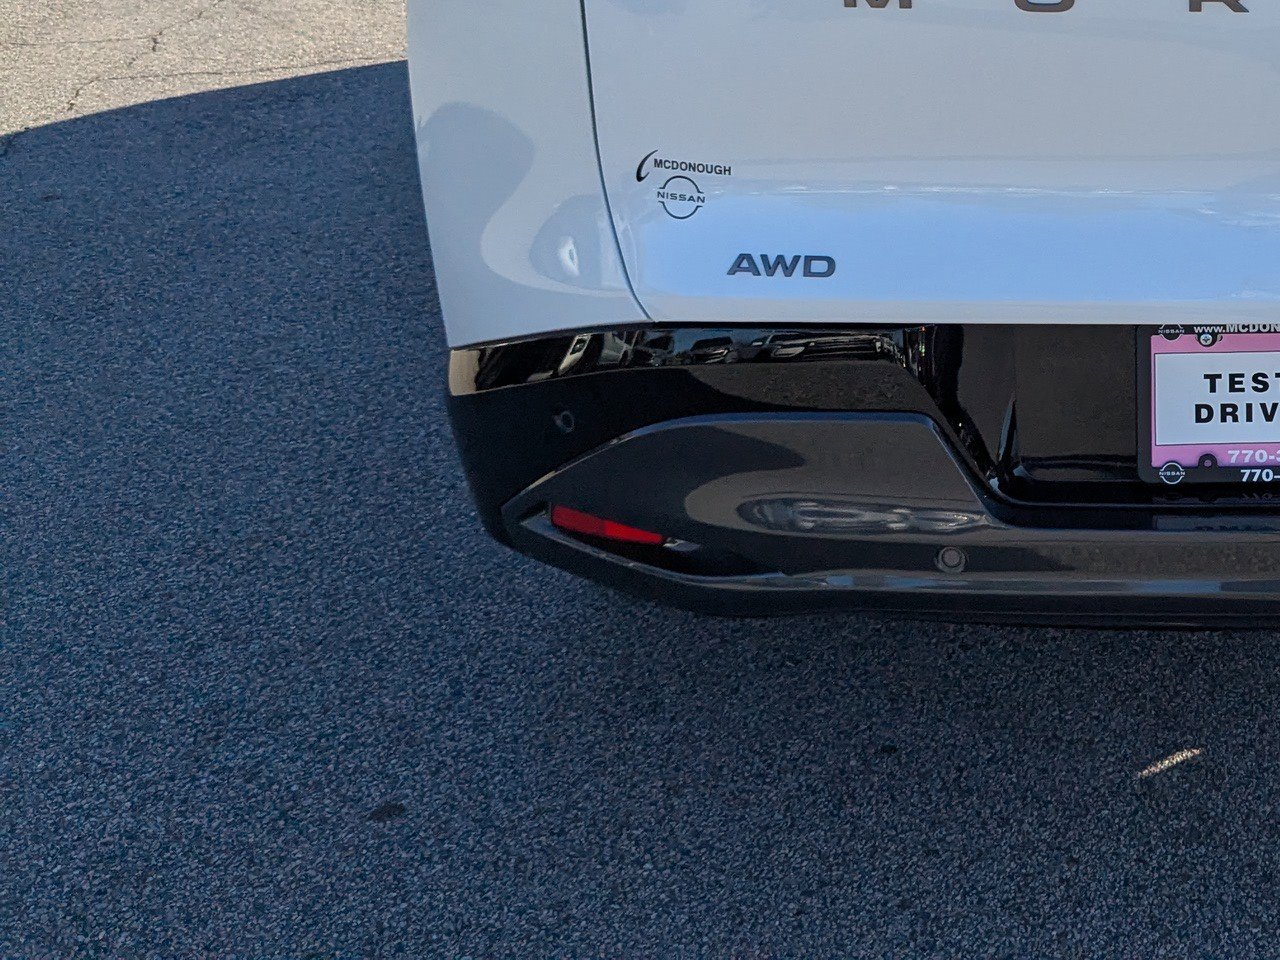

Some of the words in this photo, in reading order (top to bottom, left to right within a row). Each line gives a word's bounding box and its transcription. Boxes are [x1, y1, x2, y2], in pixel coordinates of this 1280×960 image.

[653, 158, 732, 176] MCDONOUGH
[656, 191, 706, 204] NISSAN
[726, 253, 836, 278] AWD
